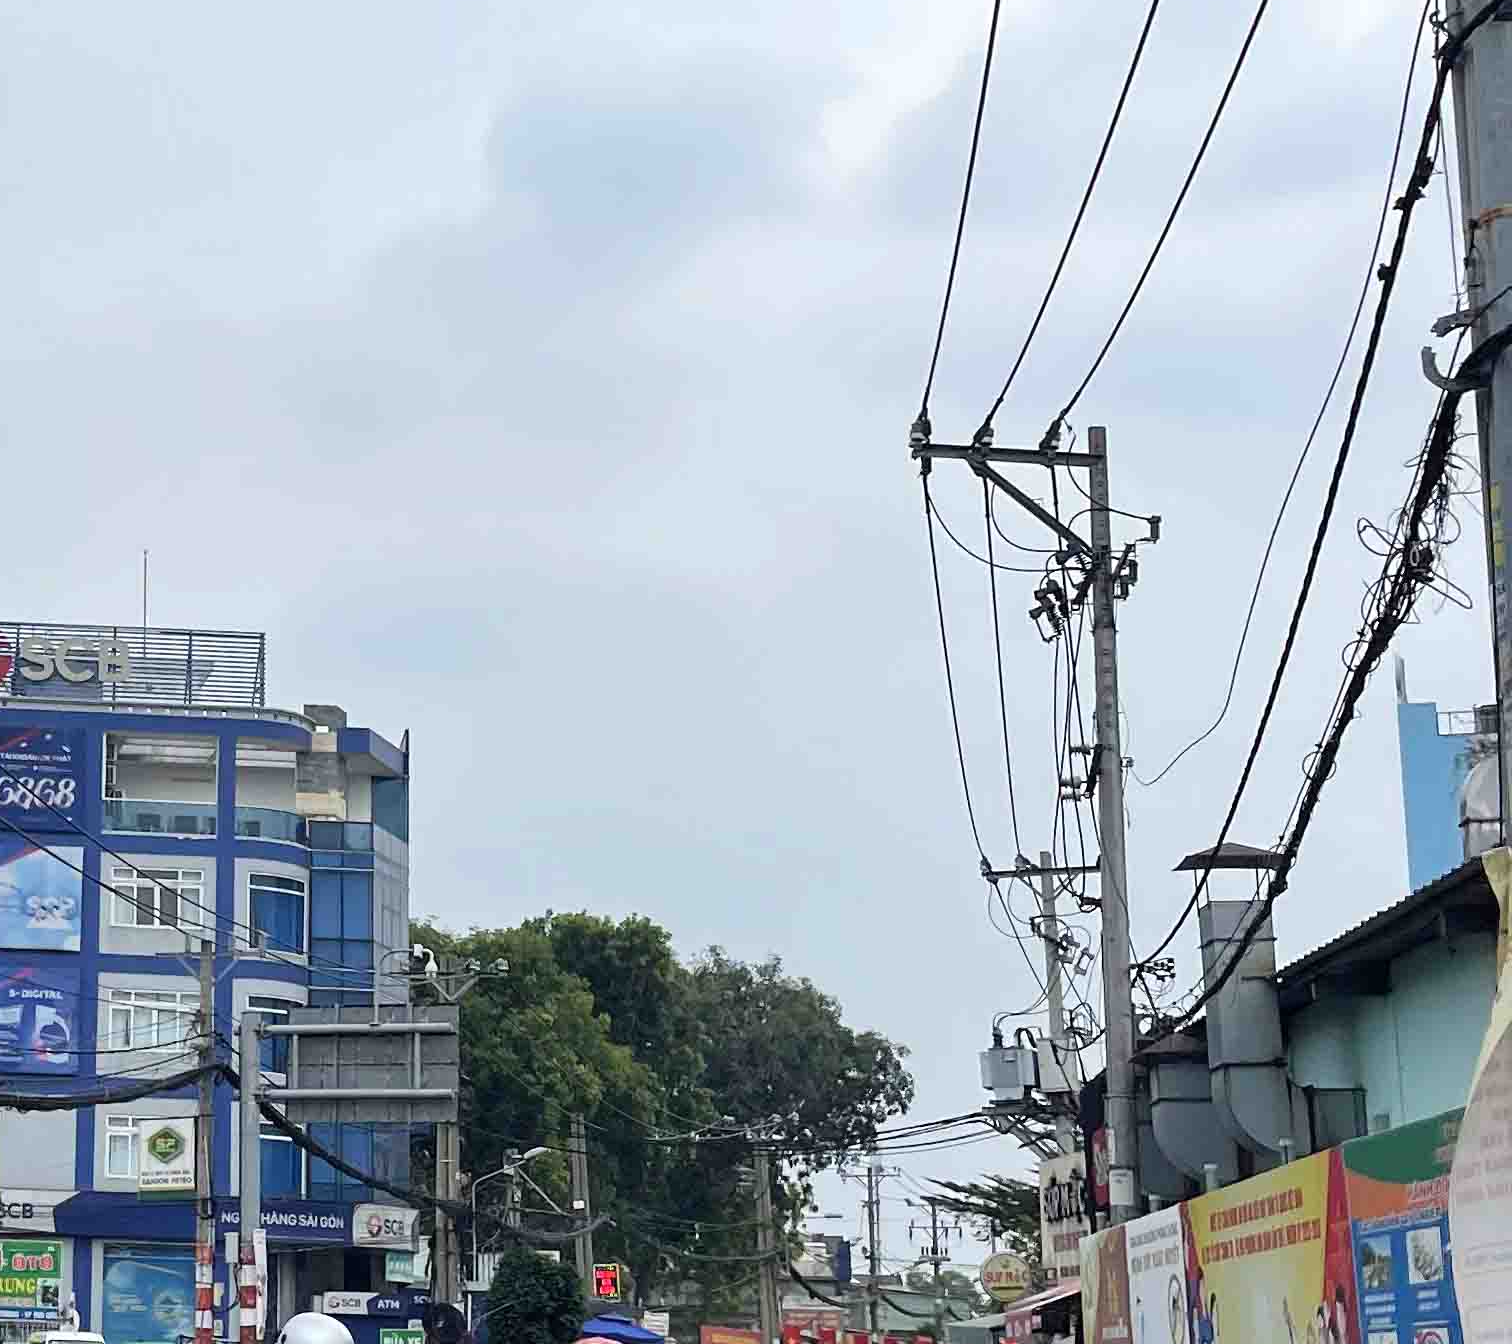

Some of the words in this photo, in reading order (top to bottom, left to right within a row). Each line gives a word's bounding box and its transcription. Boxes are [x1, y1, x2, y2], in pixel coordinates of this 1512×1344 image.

[19, 636, 131, 683] SCB
[261, 1210, 298, 1227] HÀNG
[383, 1217, 405, 1236] SCB
[377, 1299, 400, 1309] ATM
